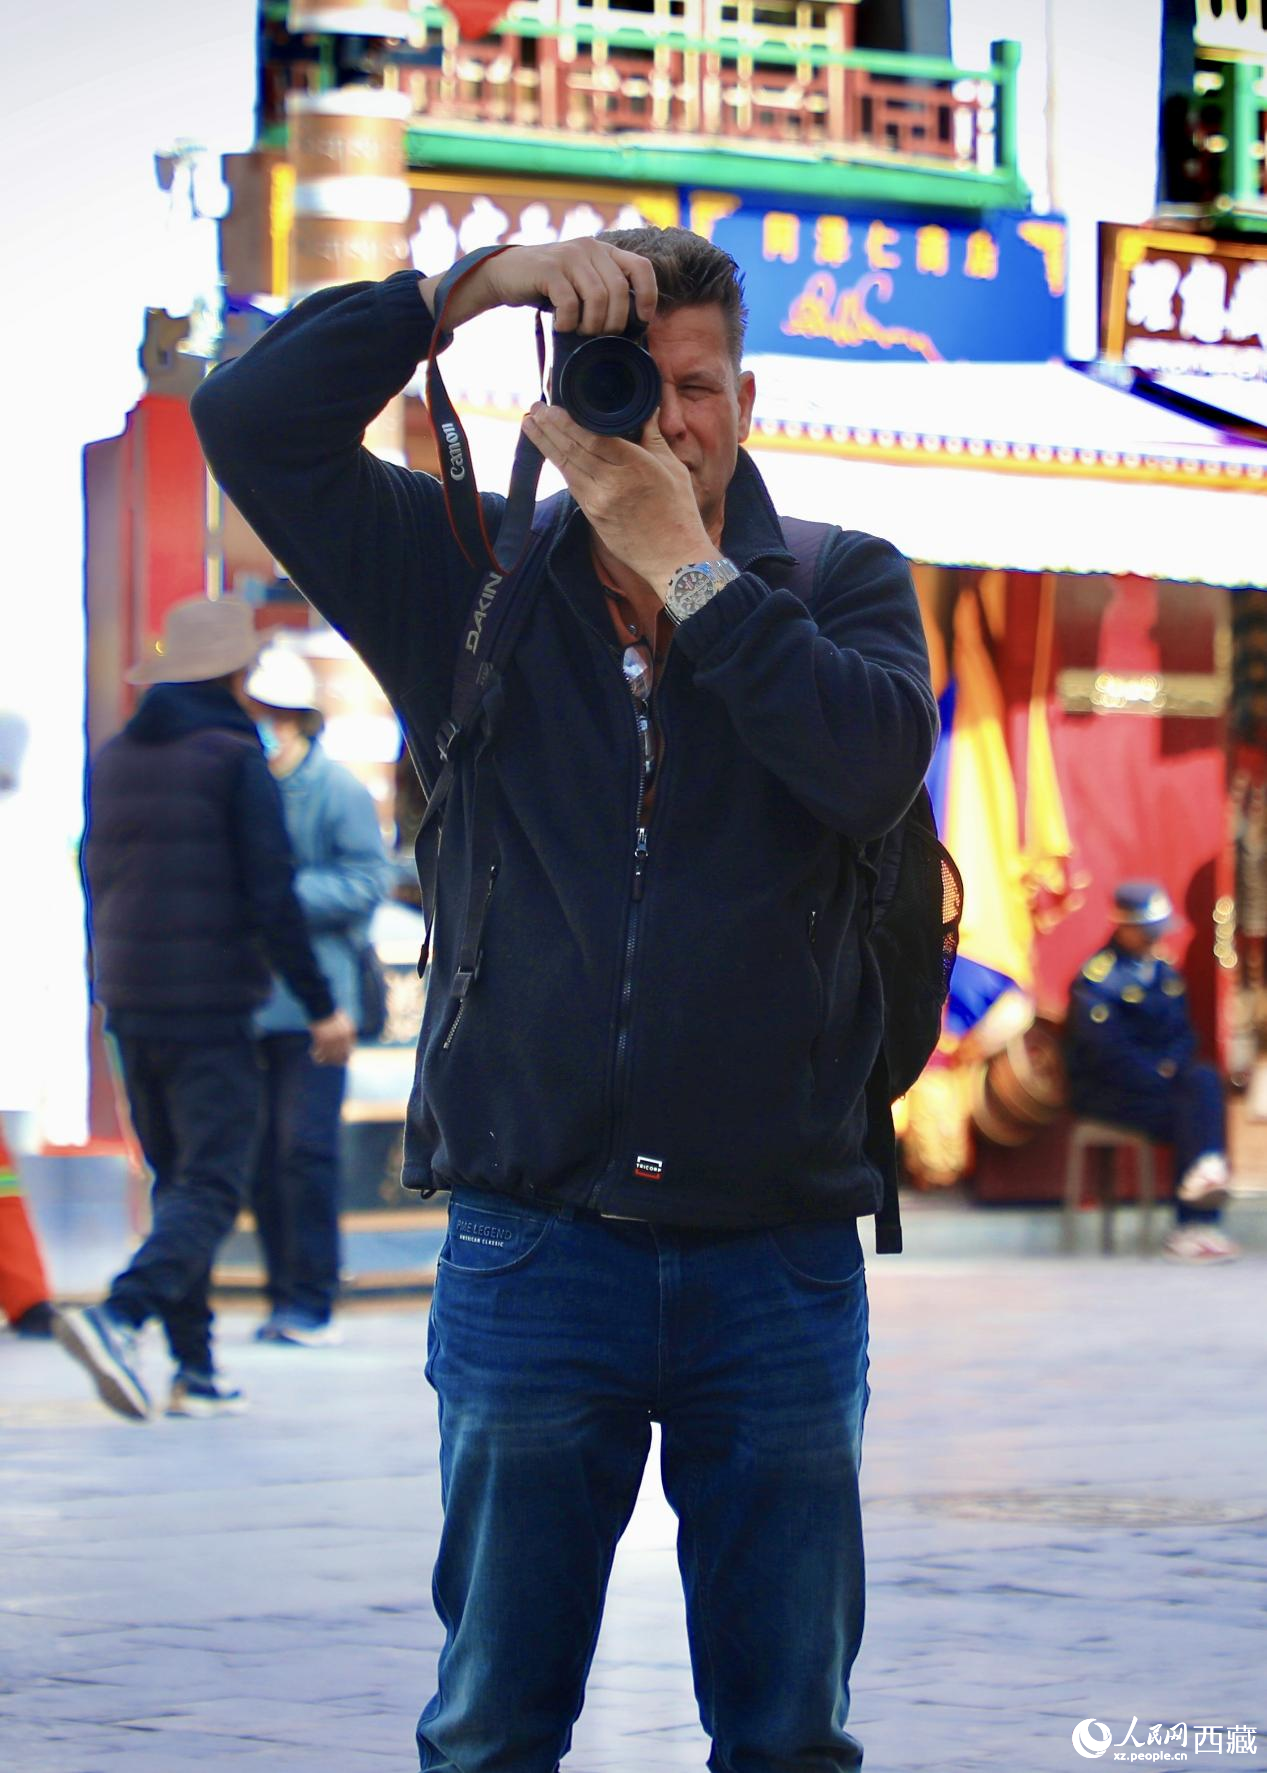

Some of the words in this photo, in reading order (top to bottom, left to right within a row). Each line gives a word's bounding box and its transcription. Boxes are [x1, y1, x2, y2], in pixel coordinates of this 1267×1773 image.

[441, 422, 466, 482] Canon
[636, 1163, 662, 1173] TRICORP
[473, 1223, 512, 1240] LEGEND
[481, 1238, 504, 1248] CLASSIC
